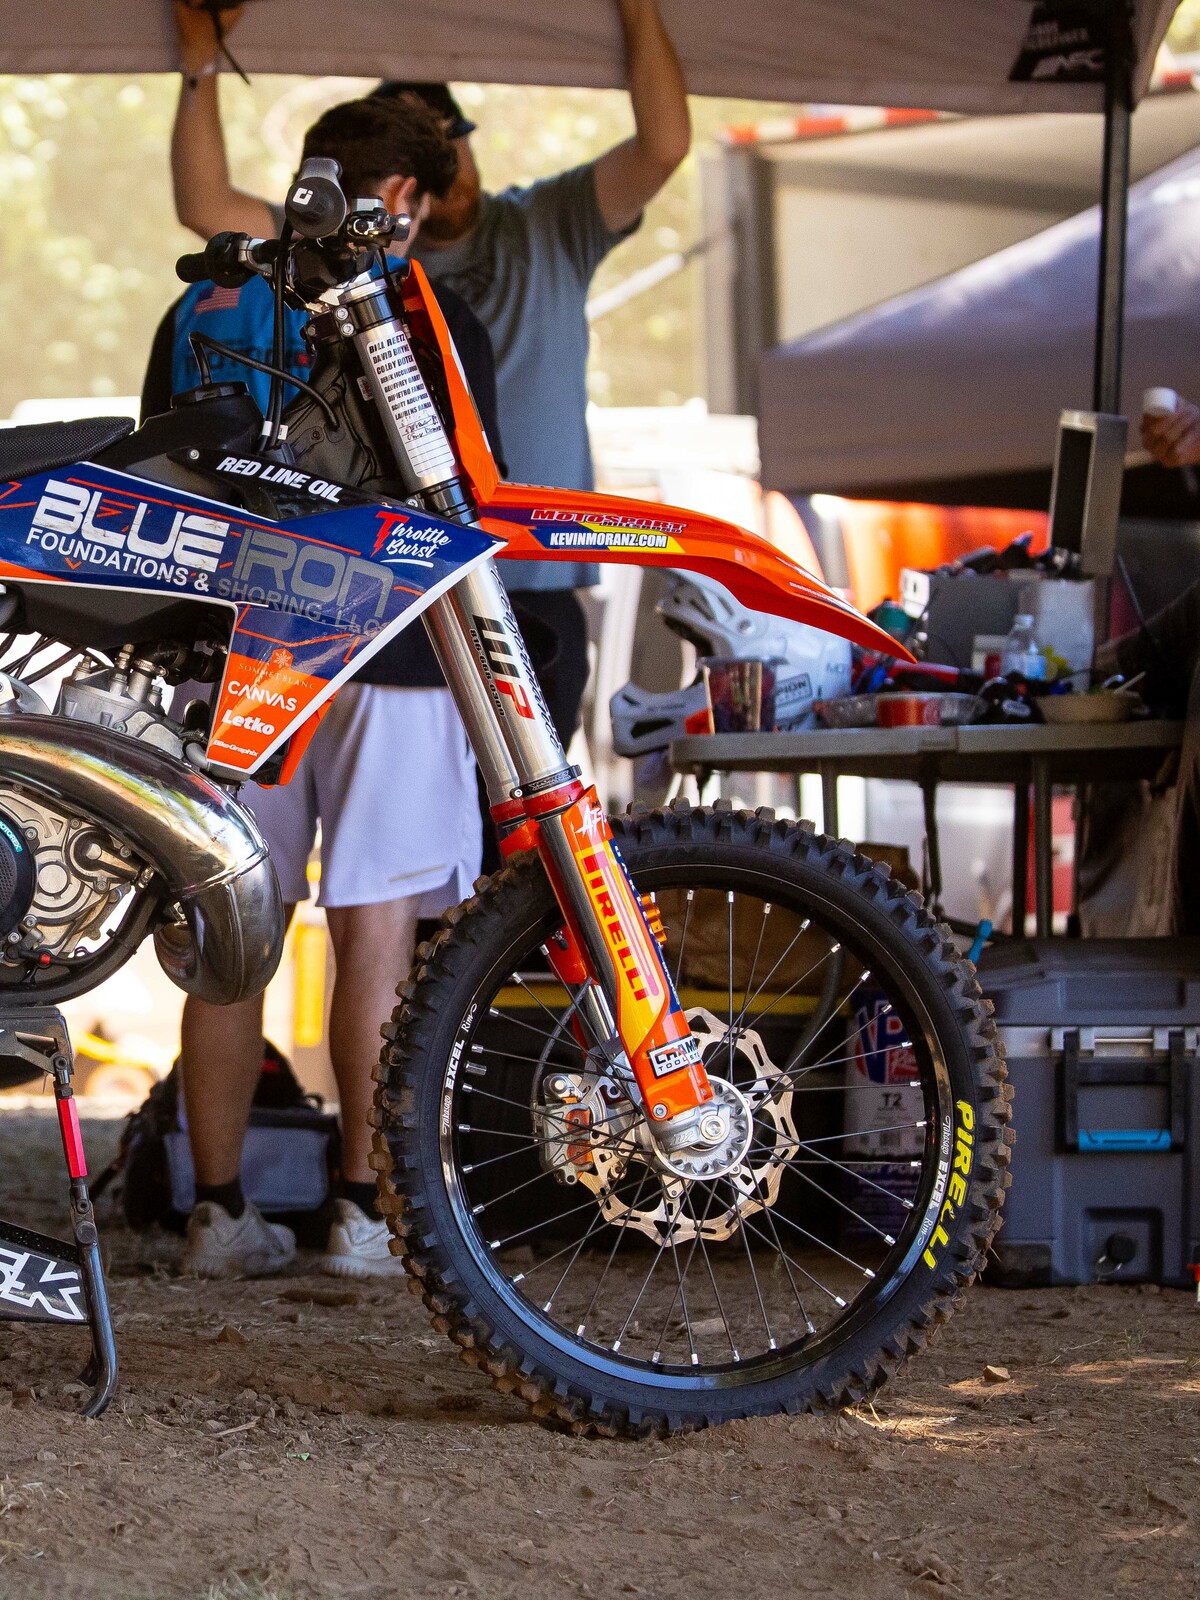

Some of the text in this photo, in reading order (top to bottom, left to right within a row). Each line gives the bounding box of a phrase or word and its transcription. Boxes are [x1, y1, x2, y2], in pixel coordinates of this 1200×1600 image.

[216, 456, 344, 503] RED LINE OIL
[31, 478, 230, 573] BLUE
[370, 511, 453, 558] Throttle
[385, 538, 441, 559] Burst
[549, 532, 668, 549] KEVINMORANZ.COM
[25, 527, 189, 587] FOUNDATIONS
[194, 572, 210, 594] &
[227, 680, 298, 712] CANVAS
[221, 708, 275, 736] Letko
[445, 1039, 465, 1091] EXCEL
[882, 1093, 902, 1107] T2
[927, 1160, 949, 1210] EXCEL
